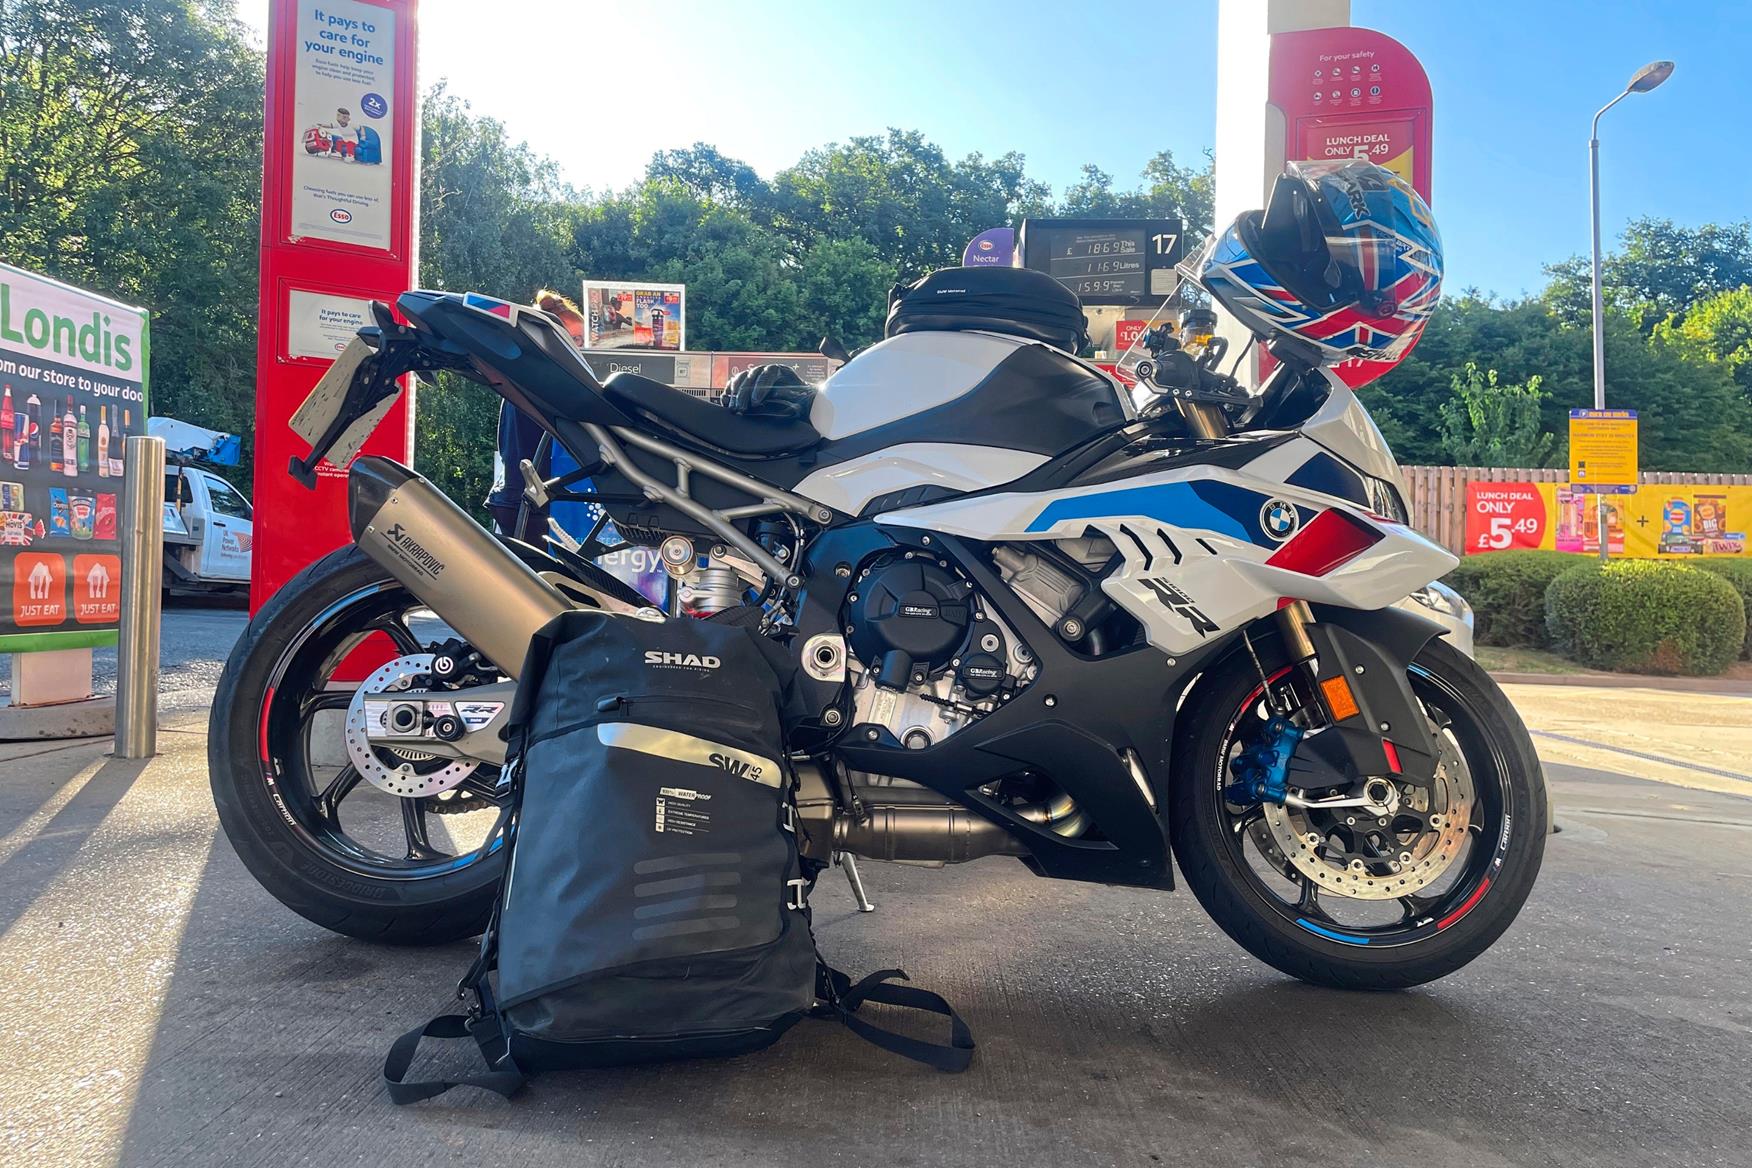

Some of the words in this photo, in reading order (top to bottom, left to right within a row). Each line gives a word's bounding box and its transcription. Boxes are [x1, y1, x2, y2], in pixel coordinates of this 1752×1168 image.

[314, 9, 325, 22] It
[328, 15, 359, 31] pays
[362, 21, 376, 33] to
[319, 30, 348, 44] care
[351, 34, 371, 48] for
[304, 40, 336, 54] your
[338, 47, 384, 66] engine
[1333, 53, 1350, 62] your
[1352, 51, 1375, 59] safety
[368, 97, 381, 110] 2x
[1326, 136, 1362, 146] LUNCH
[1363, 133, 1391, 143] DEAL
[1325, 146, 1352, 156] ONLY
[333, 212, 350, 221] Esso
[1152, 233, 1178, 255] 17
[973, 255, 999, 264] Nectar
[1, 283, 133, 372] Londis
[610, 362, 642, 374] Diesel
[18, 365, 42, 380] our
[43, 370, 76, 388] store
[78, 376, 92, 391] to
[94, 382, 120, 397] your
[1476, 491, 1508, 500] LUNCH
[1509, 492, 1533, 501] DEAL
[1476, 500, 1515, 513] ONLY
[6, 521, 23, 529] HOVIS
[1478, 517, 1538, 549] £5.49
[20, 605, 42, 617] JUST
[43, 604, 60, 615] EAT
[80, 603, 100, 616] JUST
[101, 603, 117, 613] EAT
[644, 651, 721, 669] SHAD
[709, 752, 751, 778] SW
[750, 766, 763, 781] 45
[1216, 755, 1224, 792] MOTORRAD
